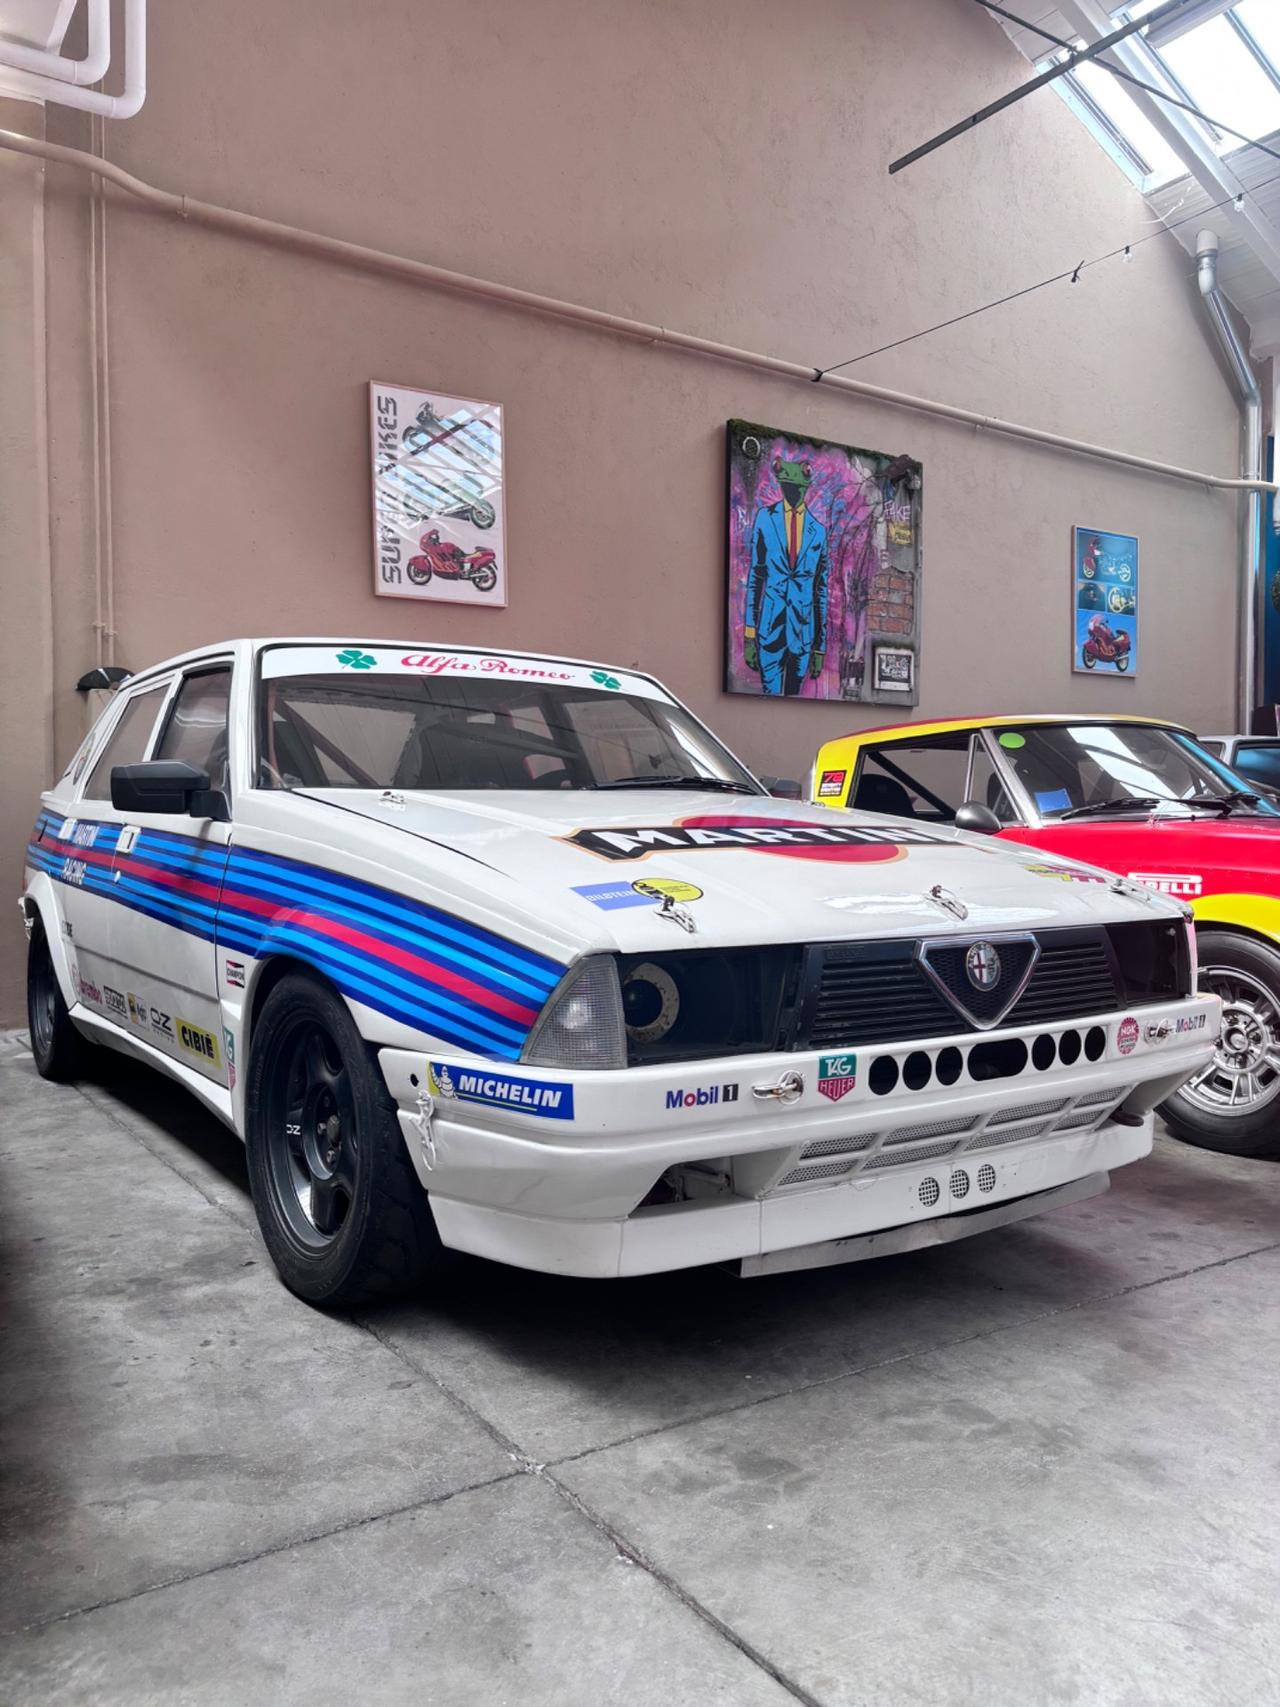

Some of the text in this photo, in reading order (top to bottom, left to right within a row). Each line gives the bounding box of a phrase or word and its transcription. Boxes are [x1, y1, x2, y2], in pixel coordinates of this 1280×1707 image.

[401, 654, 576, 681] Alfa Romeo
[591, 826, 957, 852] MARTINI
[1120, 1024, 1137, 1036] NGK
[1176, 1015, 1199, 1033] Mobil
[181, 1025, 214, 1060] CIBIÉ
[825, 1057, 852, 1076] TAG
[458, 1074, 562, 1109] MICHELIN
[665, 1085, 738, 1109] Mobil 1
[819, 1077, 855, 1101] HEUER
